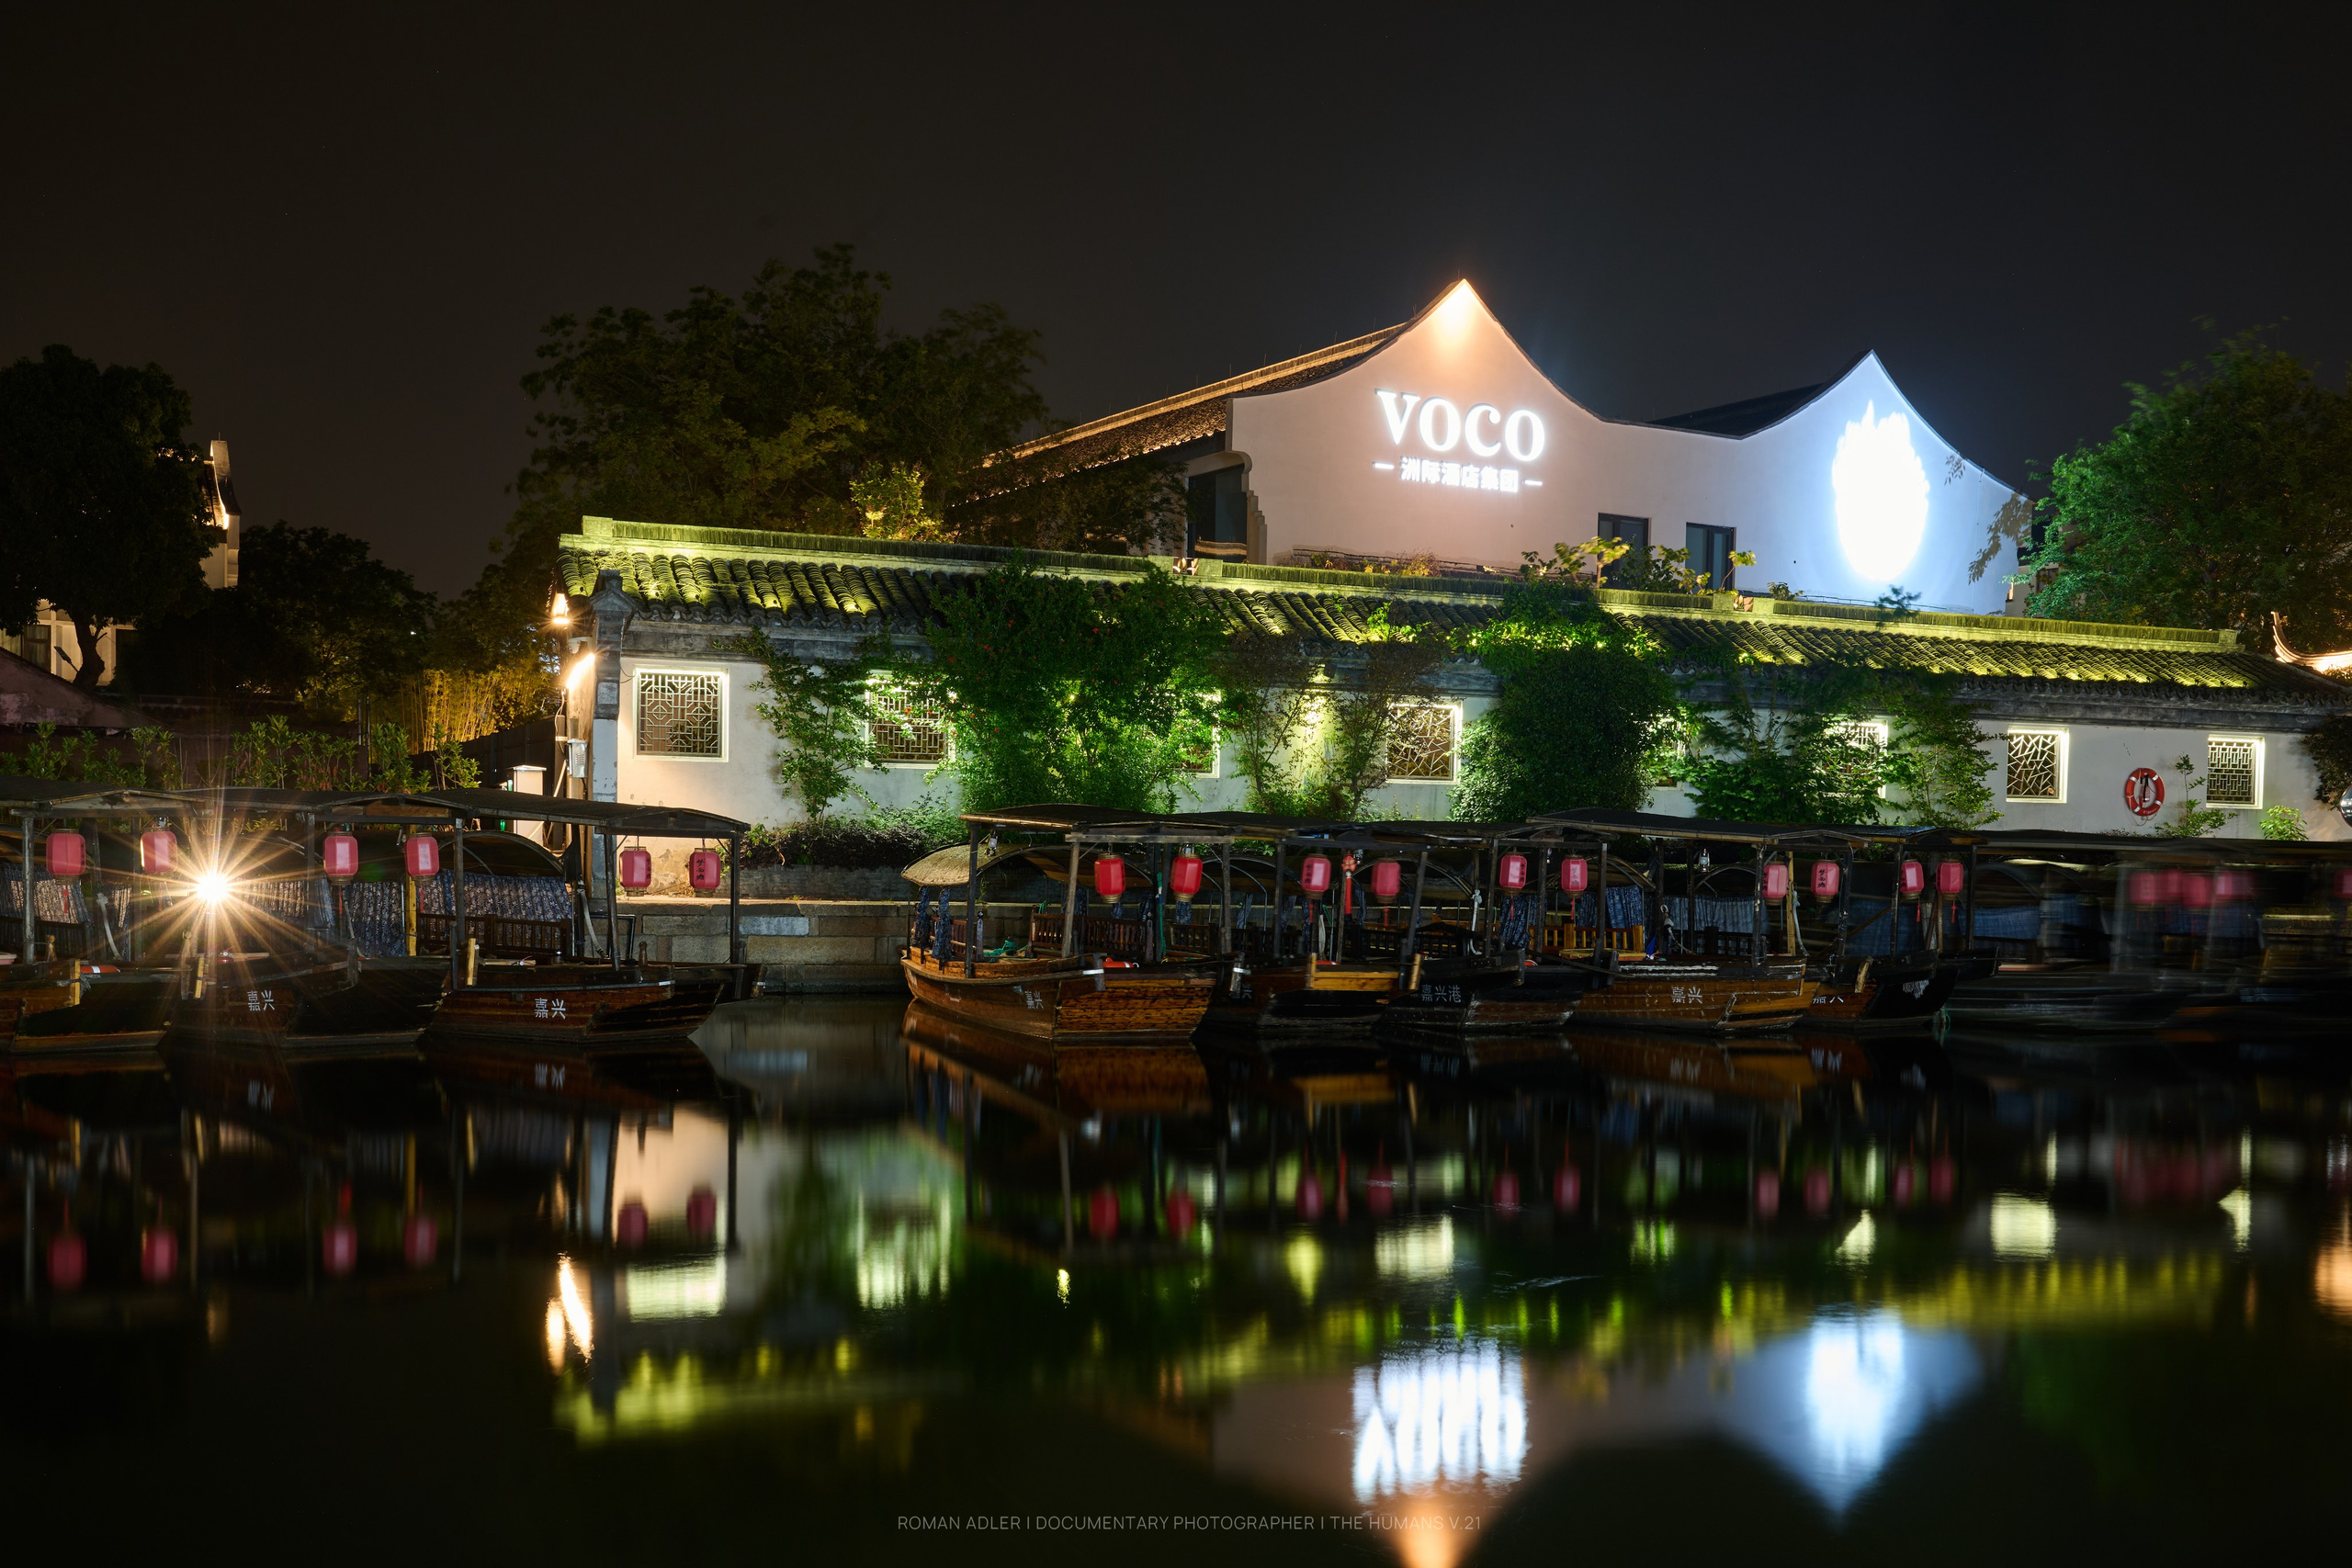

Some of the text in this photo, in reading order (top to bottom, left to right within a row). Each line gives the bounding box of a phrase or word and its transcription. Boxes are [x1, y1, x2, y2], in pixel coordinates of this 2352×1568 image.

[1374, 389, 1545, 461] VOCO
[247, 989, 275, 1011] 嘉兴
[1024, 990, 1044, 1010] 嘉兴
[1421, 984, 1462, 1002] 嘉兴港
[1670, 985, 1703, 1004] 嘉兴
[534, 998, 566, 1020] 嘉兴
